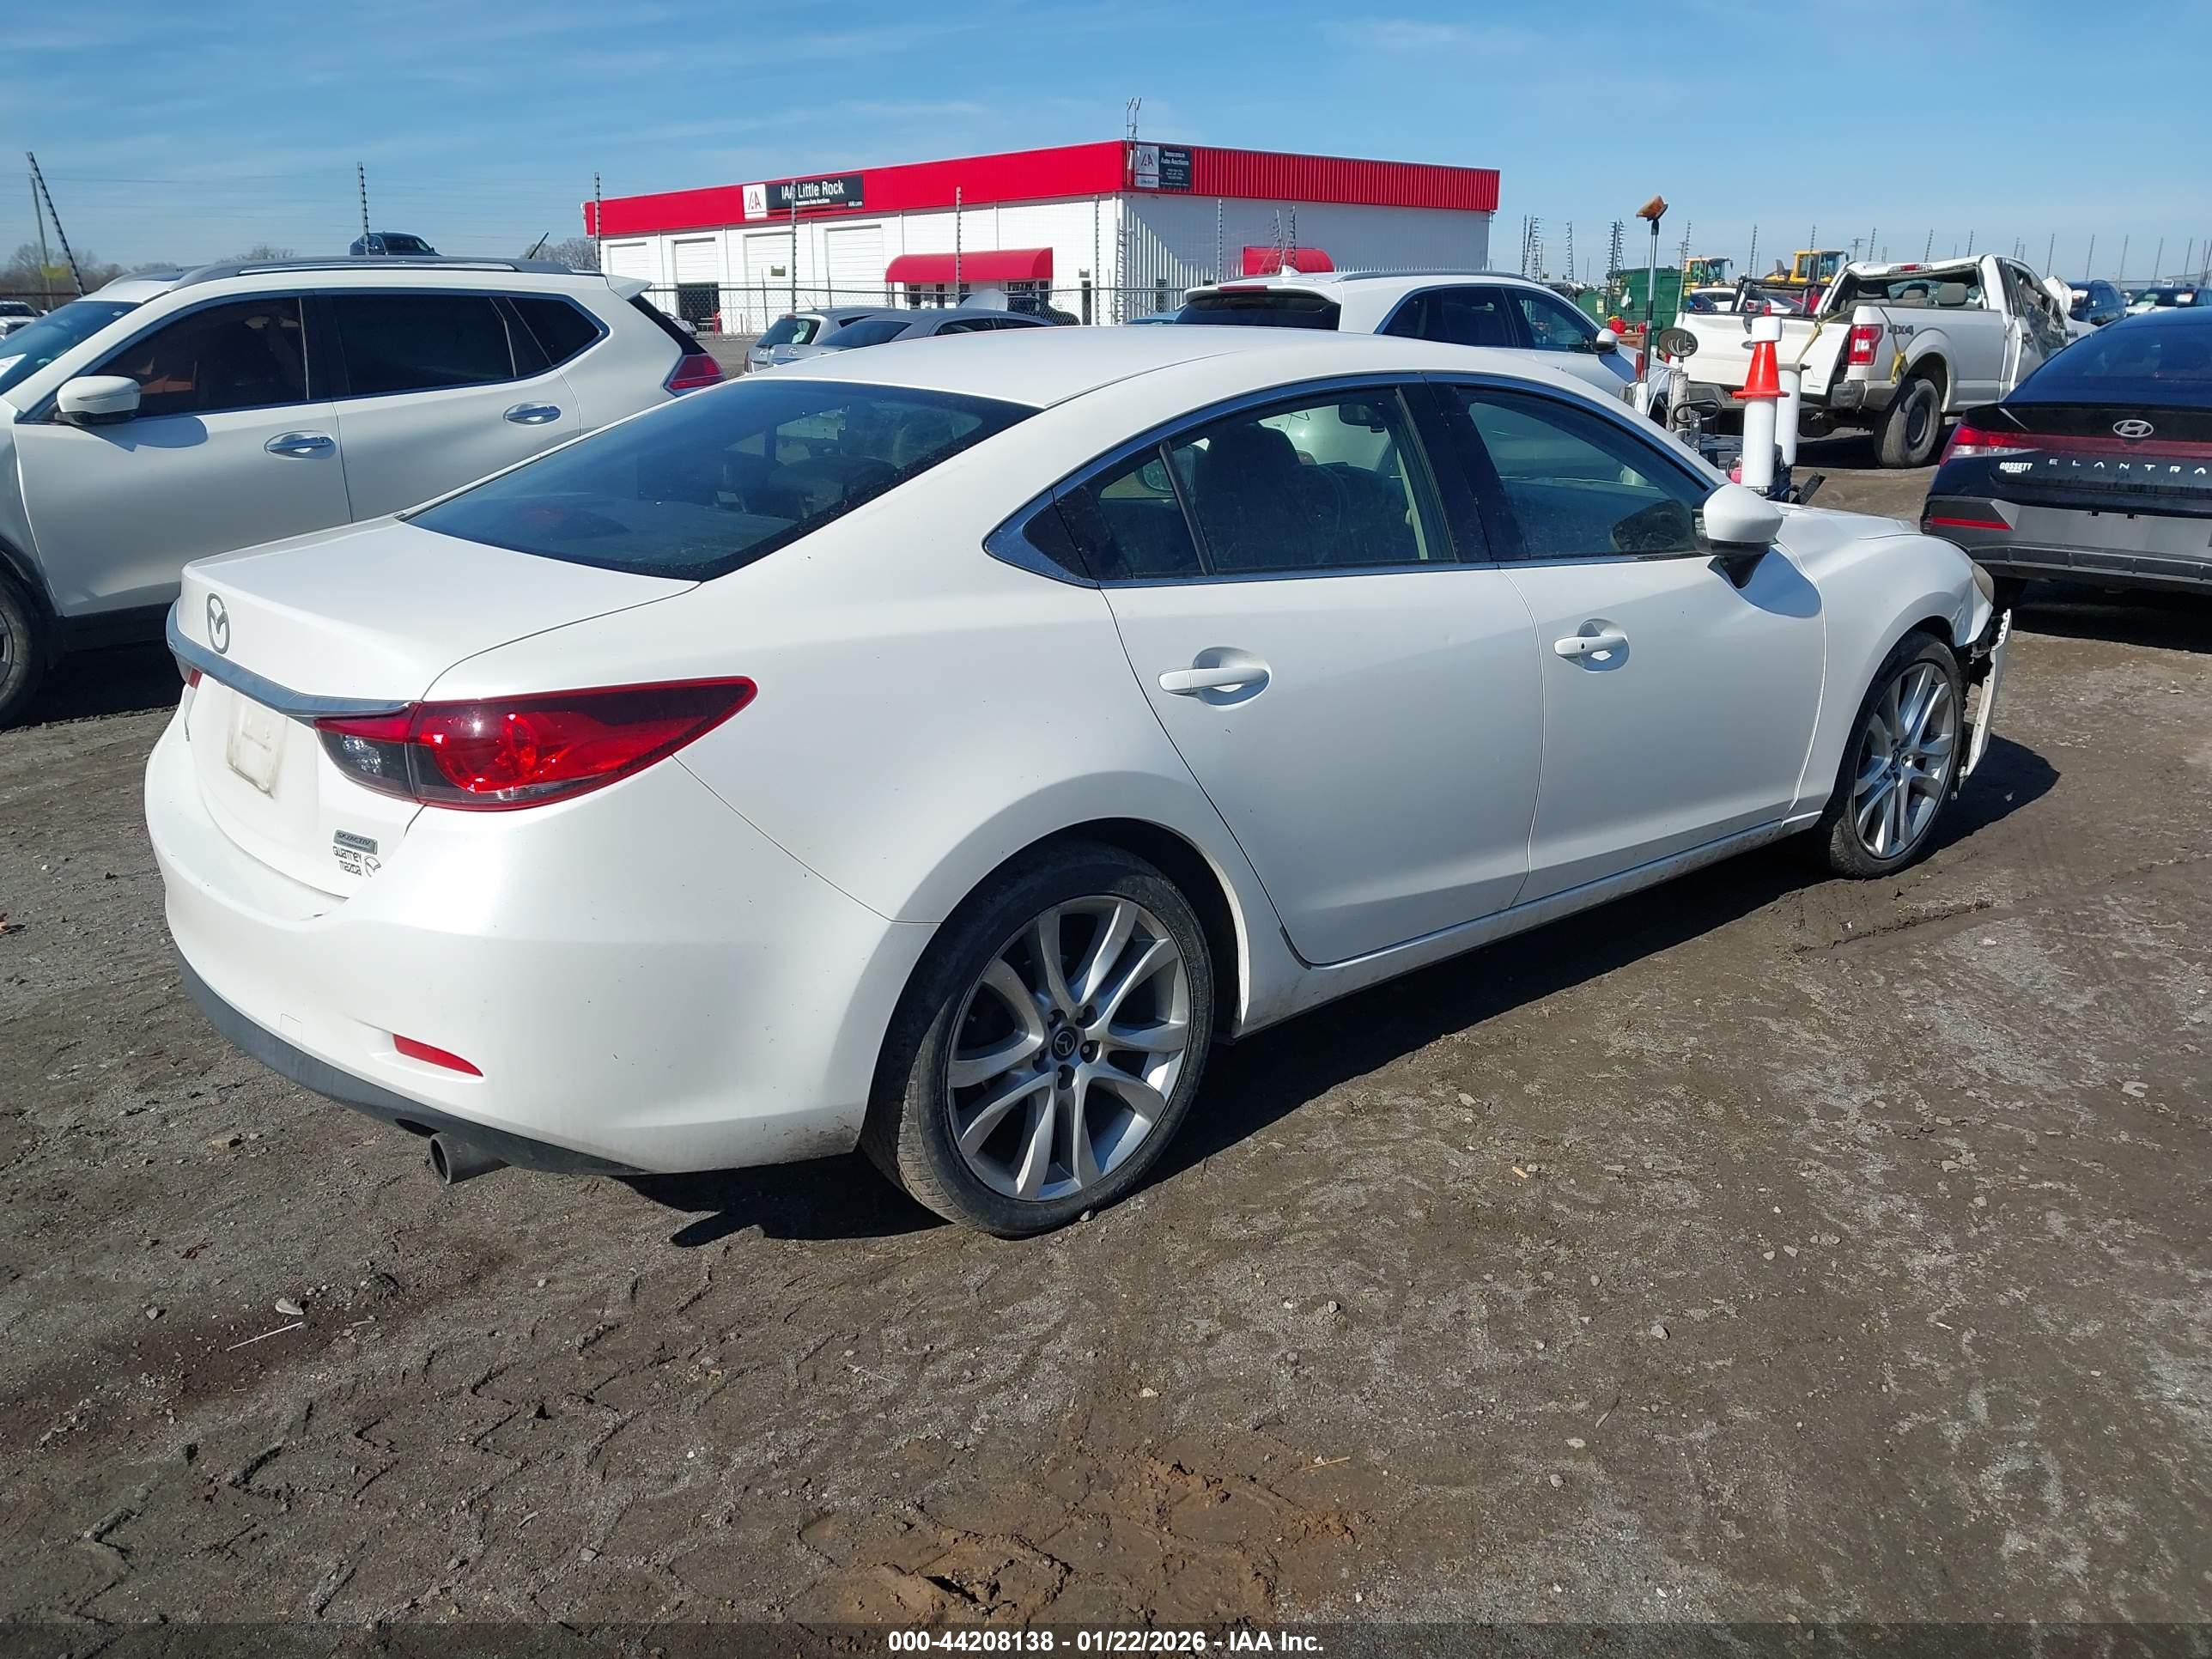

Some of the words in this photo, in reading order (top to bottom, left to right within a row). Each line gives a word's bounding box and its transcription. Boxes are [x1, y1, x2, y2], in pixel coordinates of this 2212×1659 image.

[798, 181, 820, 198] Little
[822, 179, 845, 196] Rock
[1999, 461, 2033, 471] GOSSETT
[2049, 458, 2208, 475] ELANTRA
